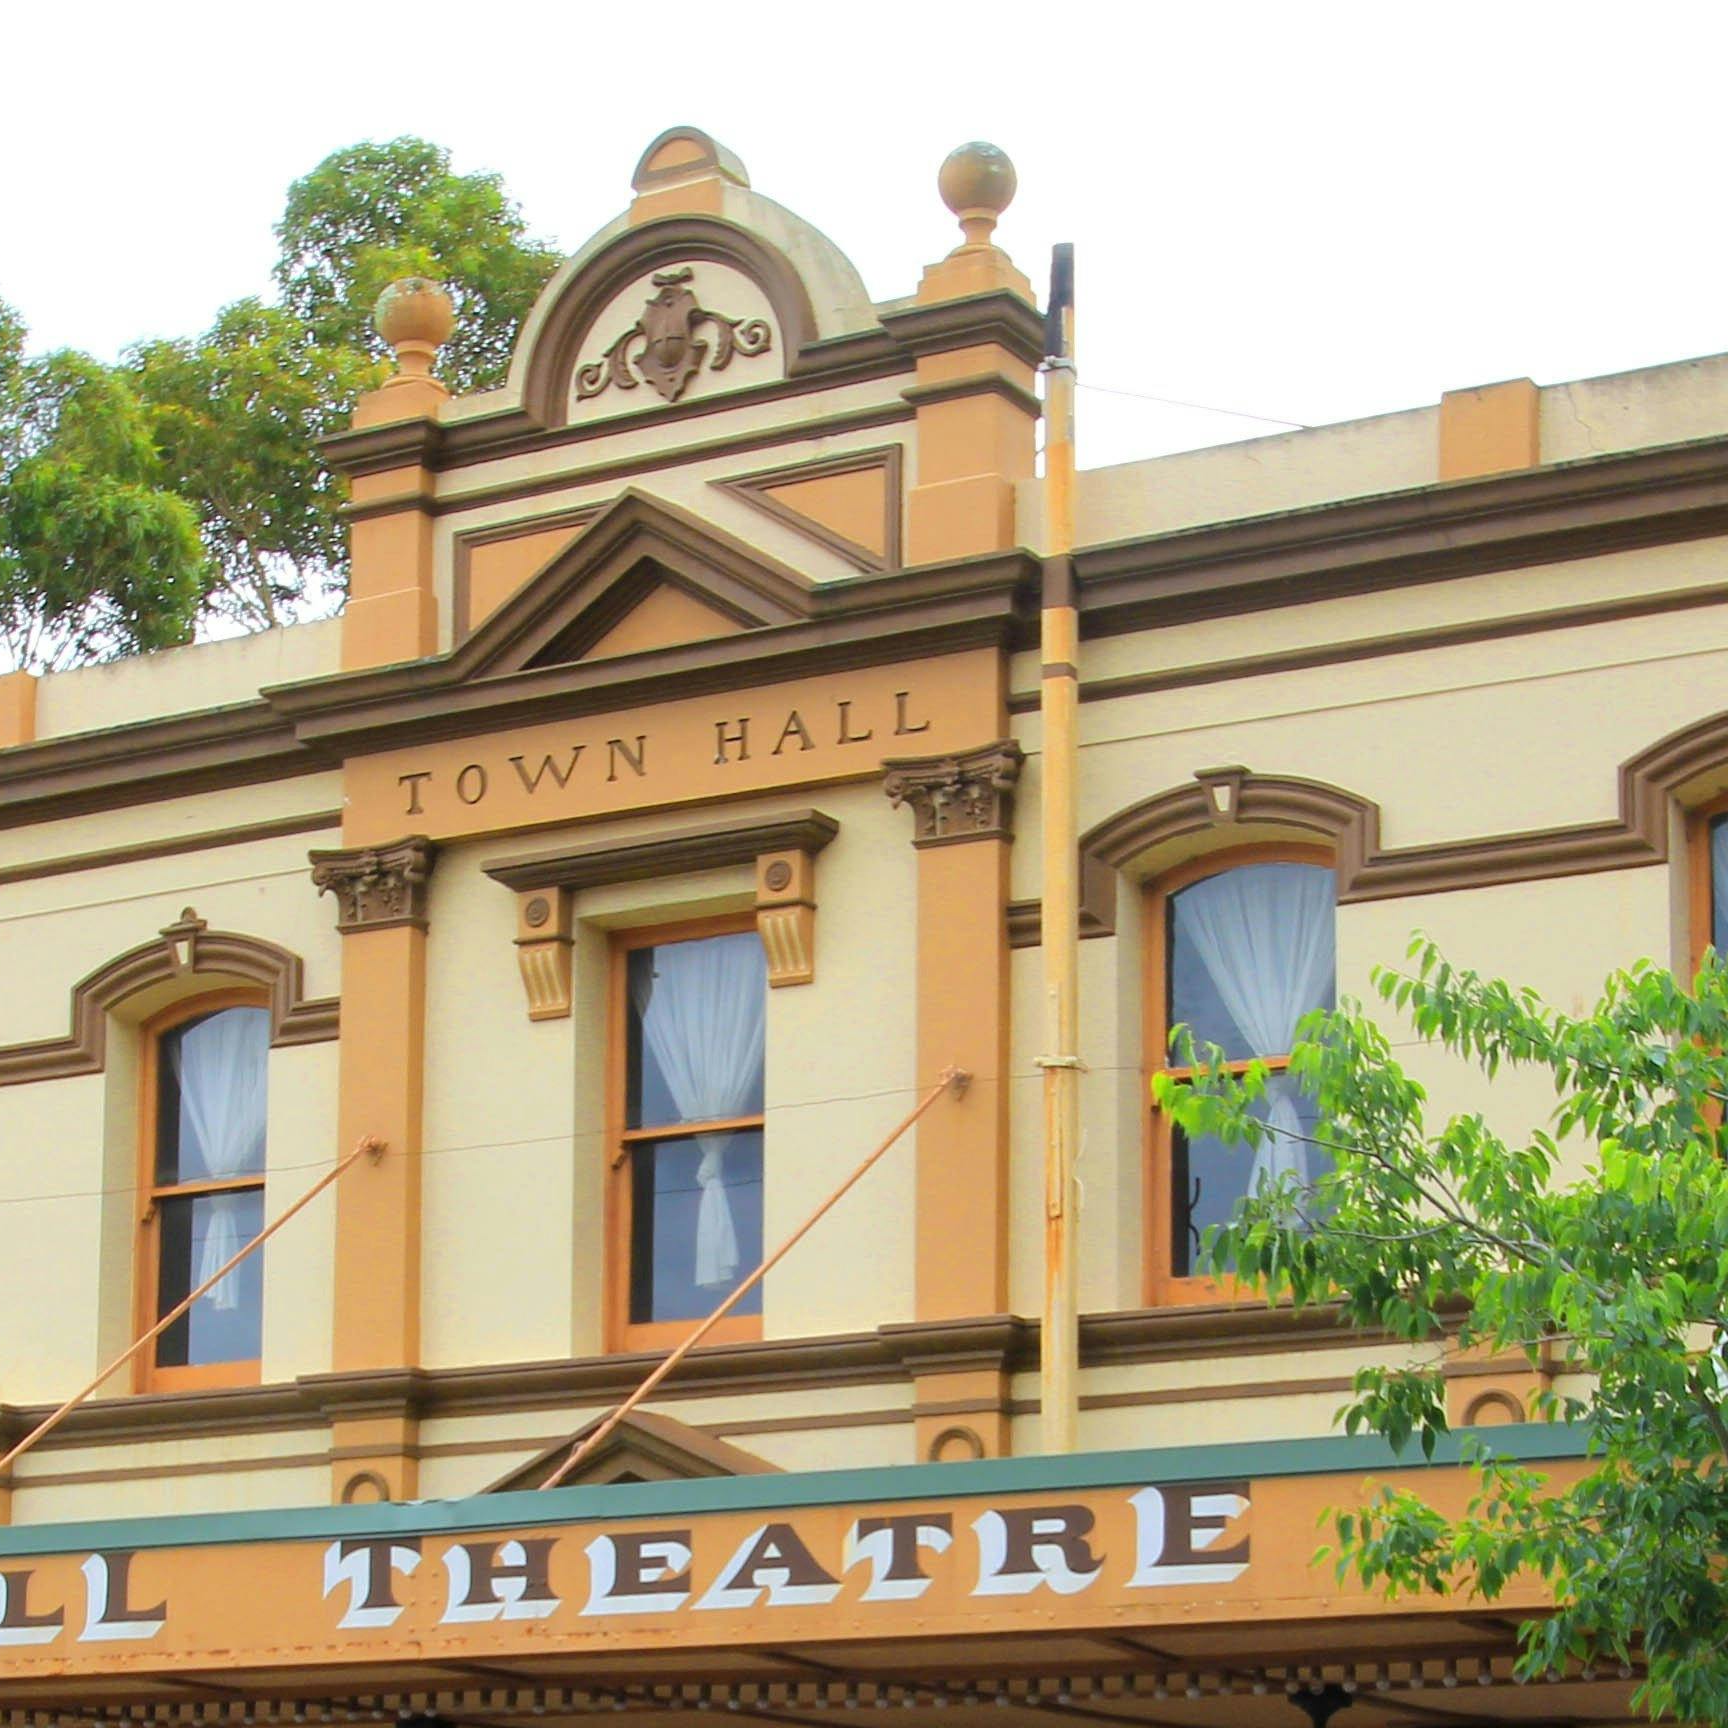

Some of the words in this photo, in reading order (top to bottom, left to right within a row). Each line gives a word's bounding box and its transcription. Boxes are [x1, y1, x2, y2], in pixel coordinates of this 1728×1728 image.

[398, 734, 648, 816] TOWN
[714, 691, 931, 766] HALL
[323, 1481, 1251, 1629] THEATRE
